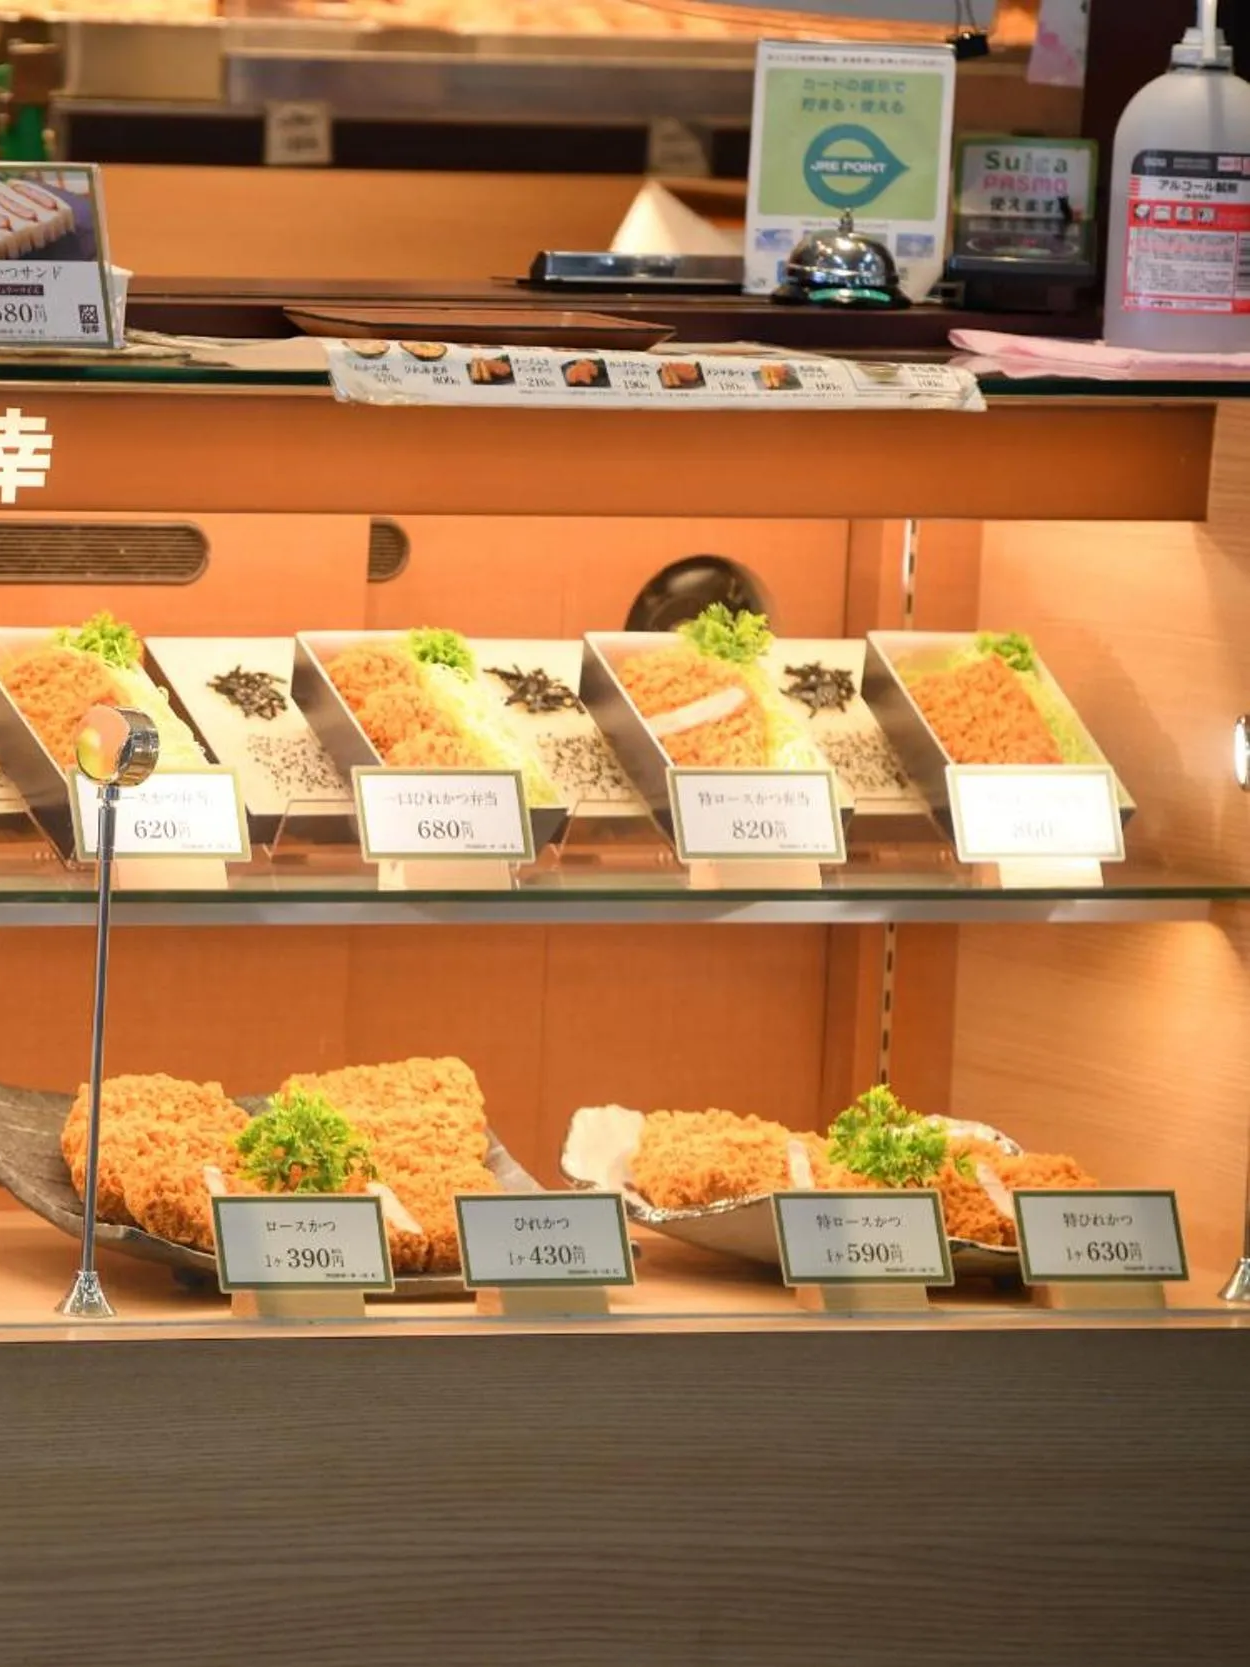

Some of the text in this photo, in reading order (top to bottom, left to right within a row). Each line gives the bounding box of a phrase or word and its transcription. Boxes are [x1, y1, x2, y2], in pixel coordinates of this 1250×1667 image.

[809, 160, 888, 173] JRE POINT
[983, 150, 1068, 173] Suica
[982, 174, 1069, 192] PASMO
[384, 789, 499, 807] 一口ひれかつ弁当
[698, 790, 811, 807] 特ロースかつ弁当
[266, 1219, 336, 1233] ロースかつ
[514, 1216, 570, 1231] ひれかつ
[816, 1213, 902, 1230] 特ロースかつ
[1063, 1212, 1134, 1228] 特ひれかつ
